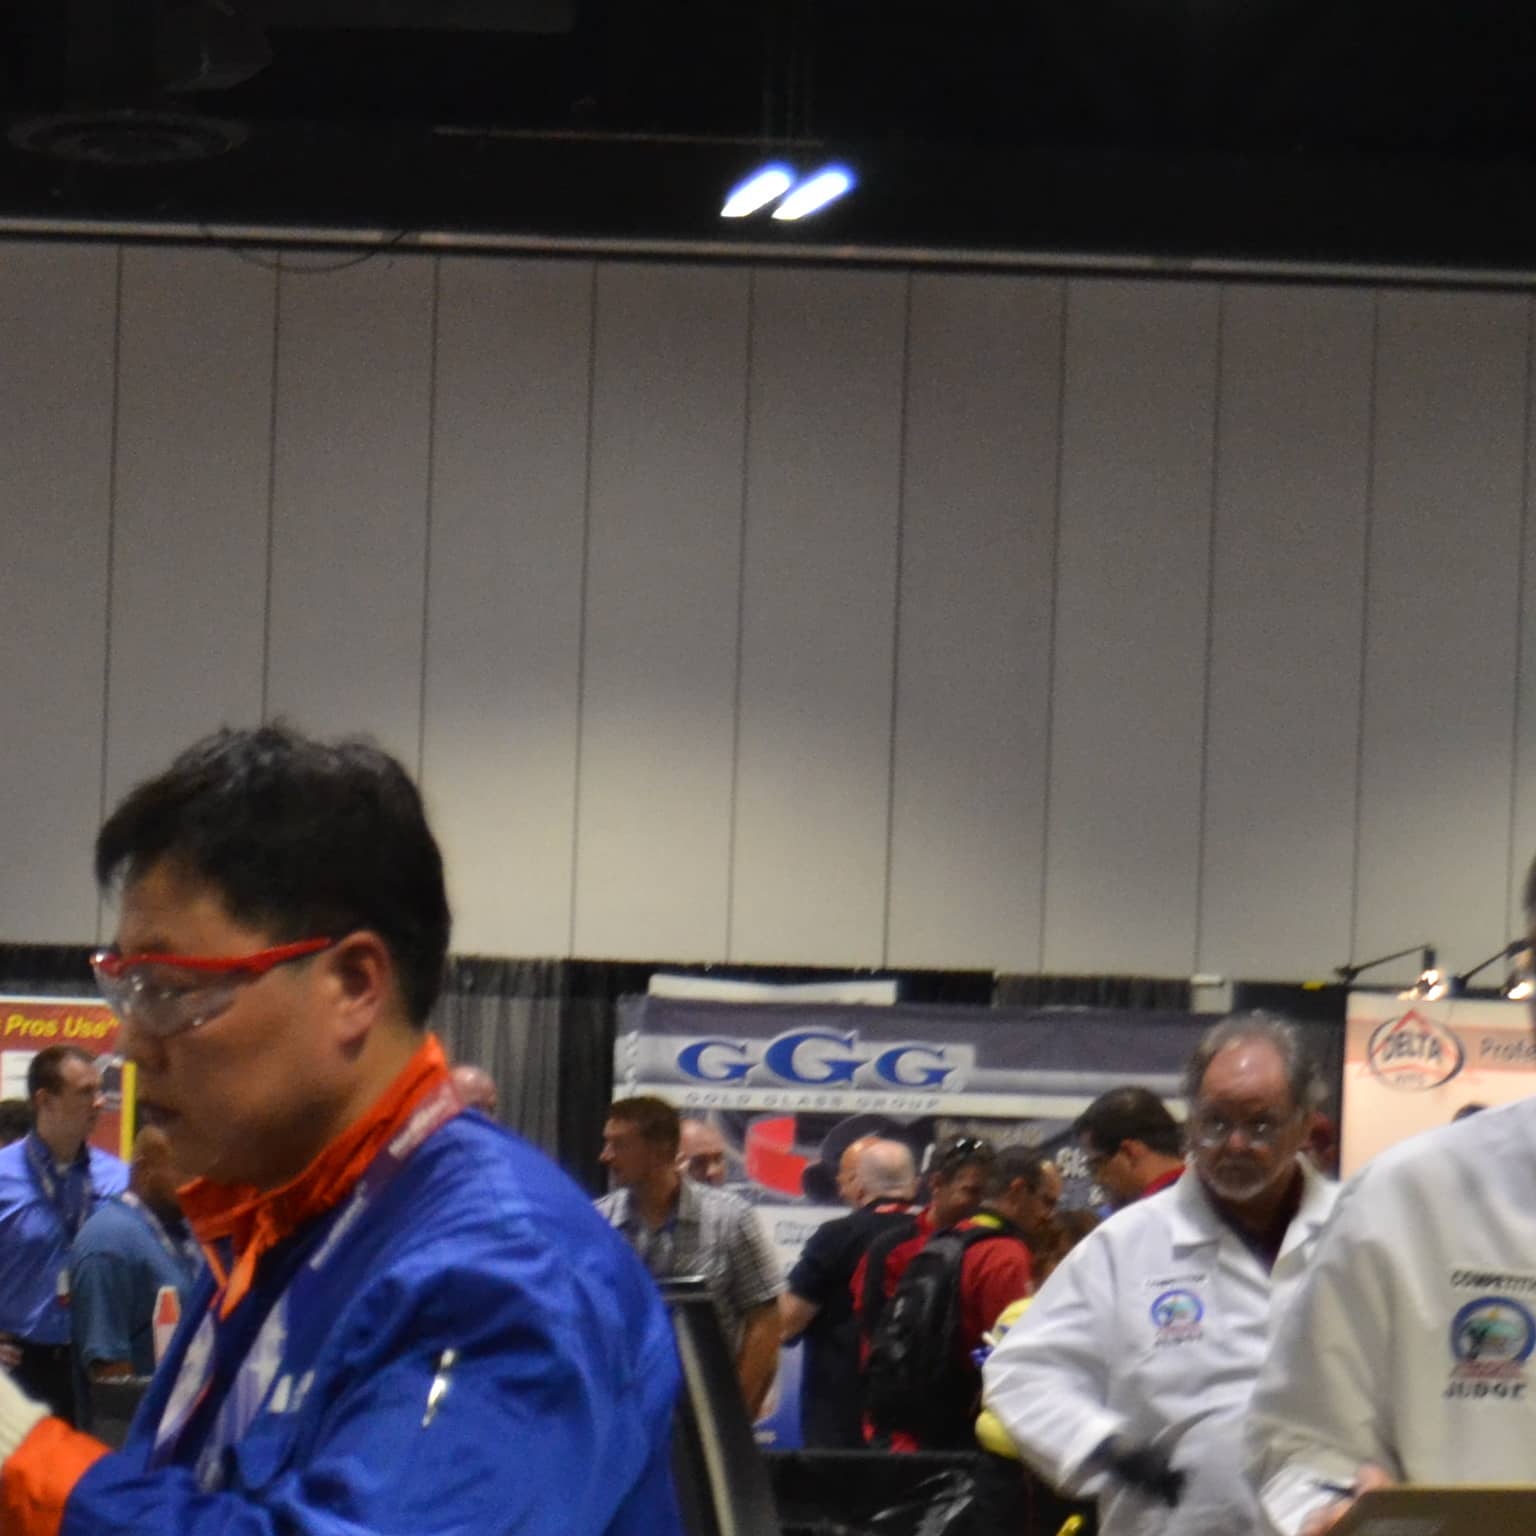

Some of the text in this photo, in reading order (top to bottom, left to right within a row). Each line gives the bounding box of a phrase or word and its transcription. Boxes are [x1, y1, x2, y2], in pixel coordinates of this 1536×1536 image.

[4, 1014, 58, 1037] Pros
[677, 1027, 954, 1088] GGG
[1382, 1030, 1444, 1064] DELTA
